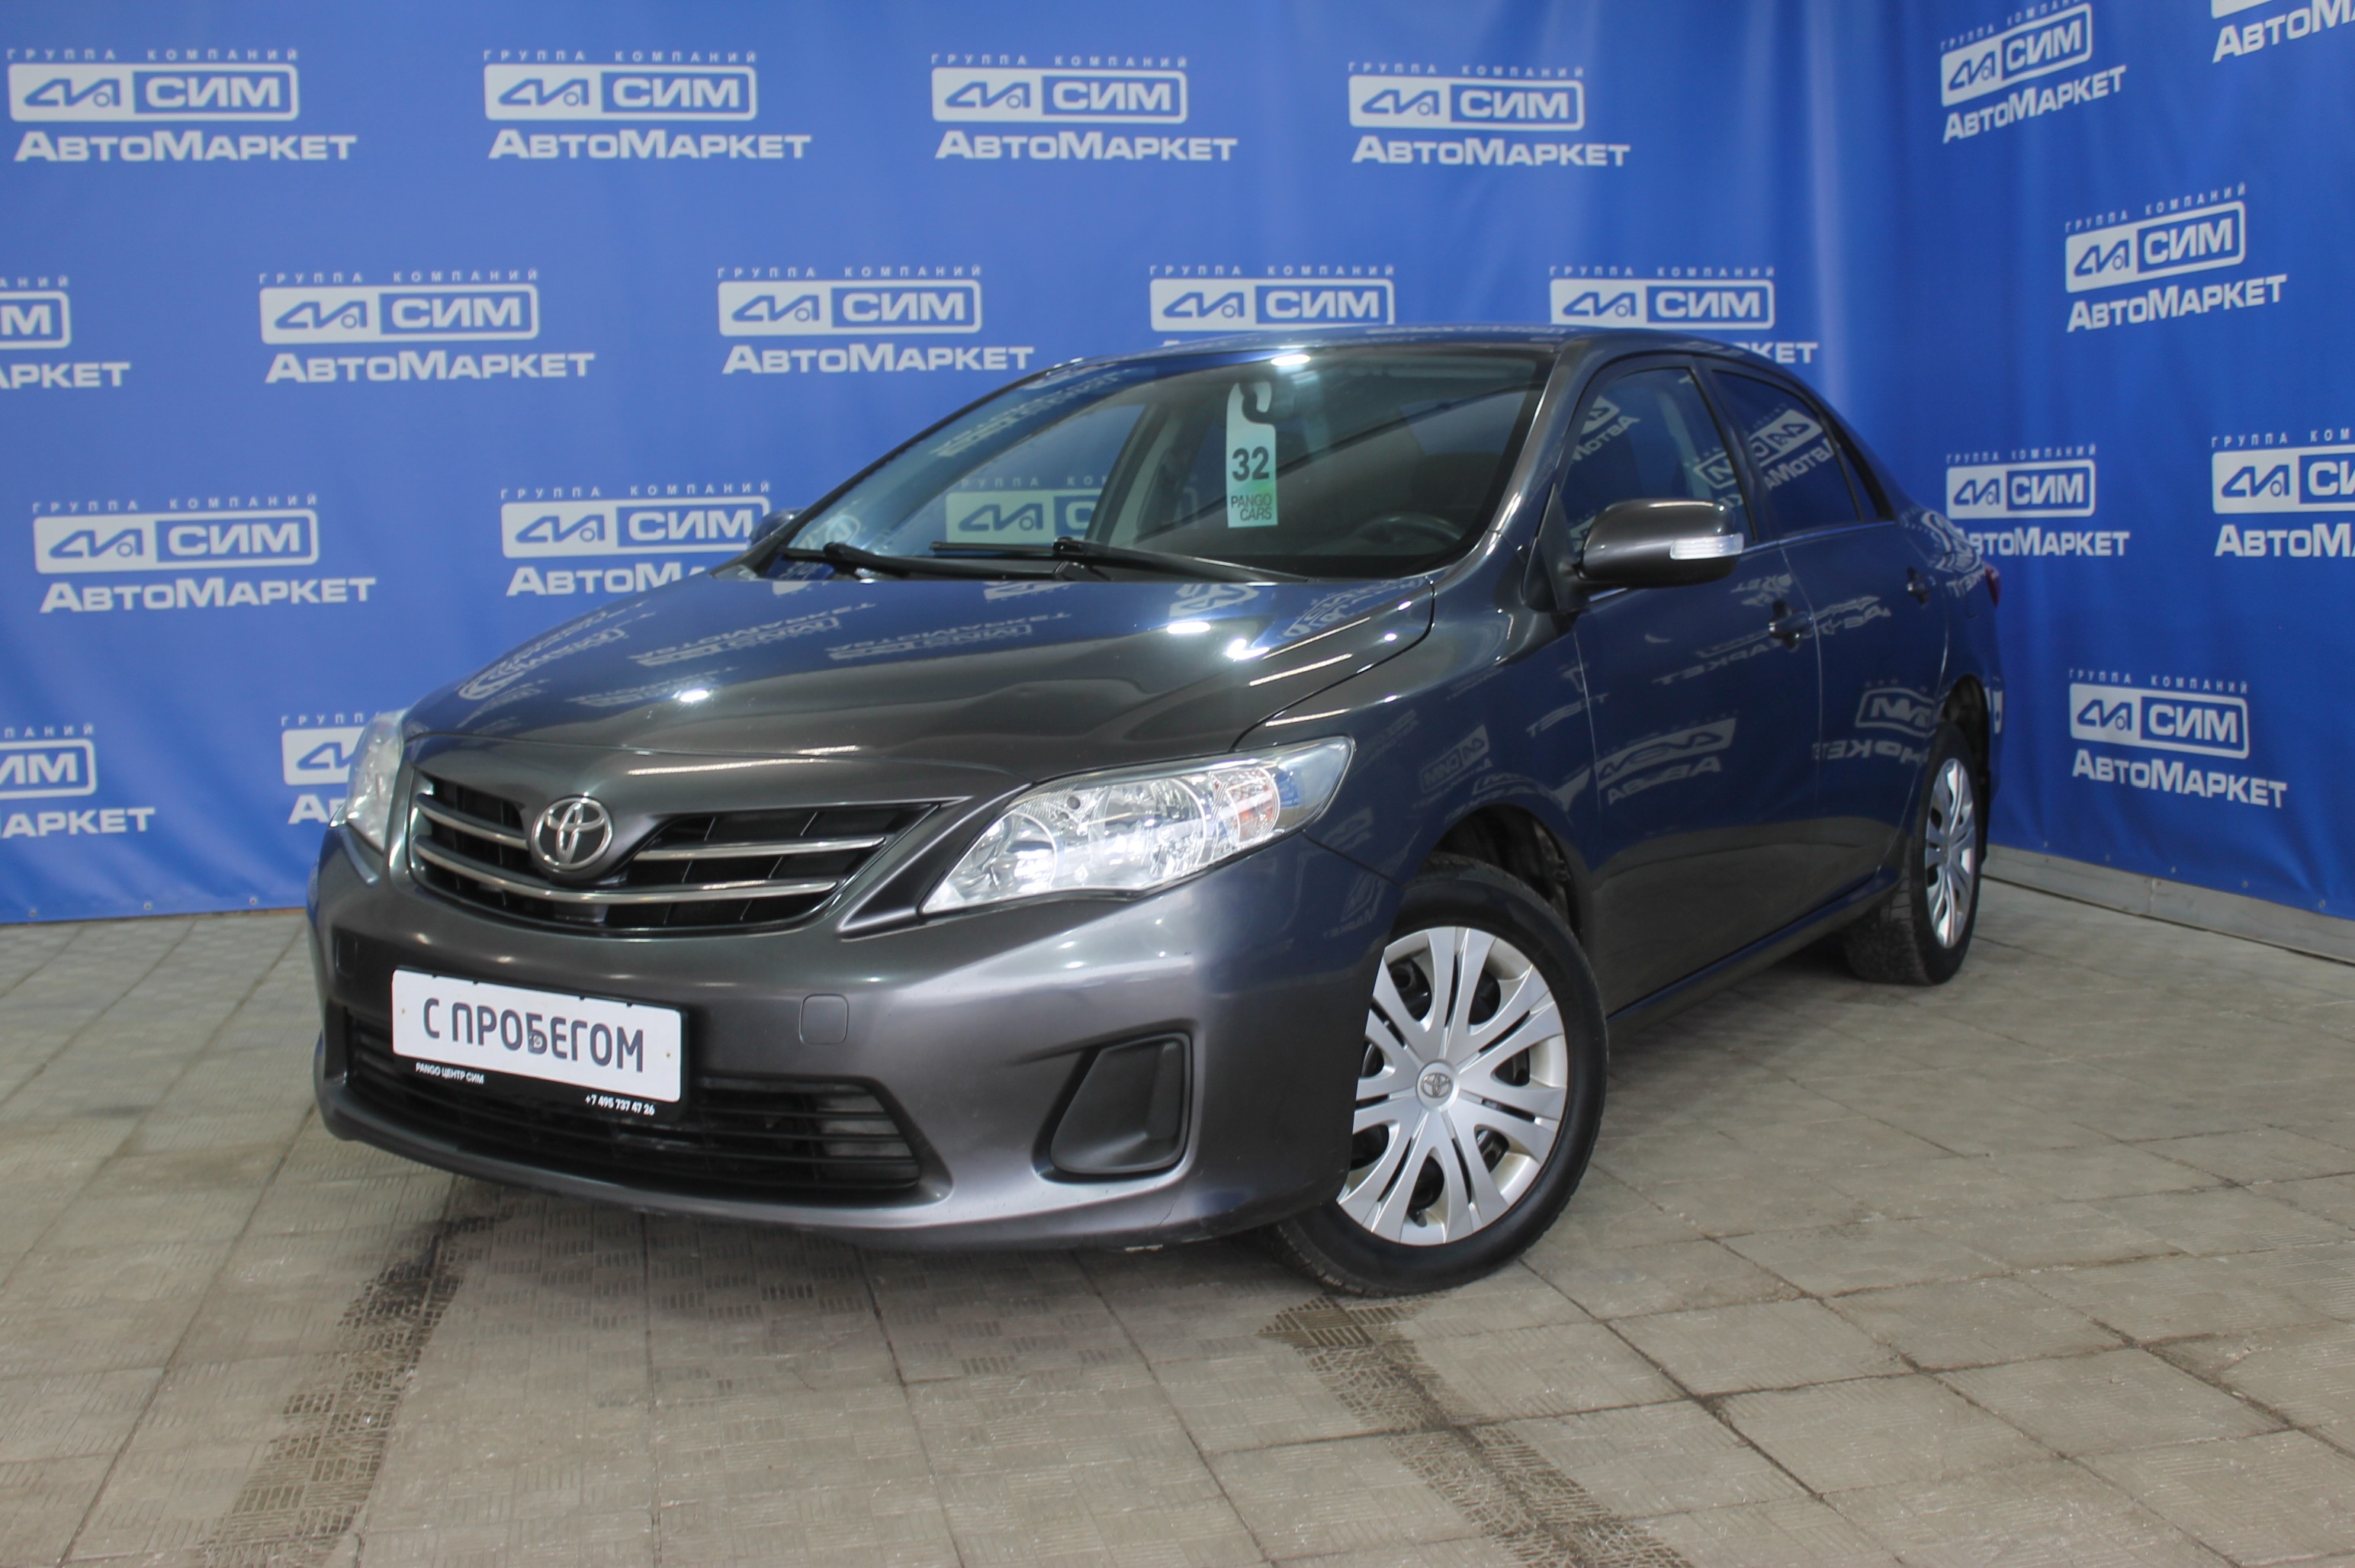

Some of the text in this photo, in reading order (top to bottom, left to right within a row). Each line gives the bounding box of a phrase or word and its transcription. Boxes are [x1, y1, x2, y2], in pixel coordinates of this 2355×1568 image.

[2006, 19, 2081, 71] СИМ
[2212, 0, 2355, 63] АВТОМ
[7, 48, 297, 60] ГРУППА КОМПАНИЙ
[484, 50, 756, 63] ГРУППА КОМПАНИЙ
[931, 53, 1187, 68] ГРУППА КОМПАНИЙ
[1348, 61, 1584, 78] ГРУППА КОМПАНИЙ
[146, 77, 279, 107] СИМ
[613, 78, 738, 107] СИМ
[1053, 82, 1171, 110] СИМ
[1460, 90, 1569, 118] СИМ
[2066, 182, 2246, 232] ГРУППА КОМПАНИЙ
[2145, 218, 2232, 264] СИМ
[259, 268, 537, 284] ГРУППА КОМПАНИЙ
[718, 265, 981, 278] ГРУППА КОМПАНИЙ
[1149, 265, 1394, 276] ГРУППА КОМПАНИЙ
[1549, 265, 1775, 277] ГРУППА КОМПАНИЙ
[392, 297, 520, 328] СИМ
[843, 293, 964, 321] СИМ
[1266, 291, 1379, 318] СИМ
[1656, 291, 1760, 317] СИМ
[2212, 432, 2288, 447] ГРУППА
[1232, 446, 1270, 481] 32
[500, 481, 769, 500] ГРУППА КОМПАНИЙ
[1230, 493, 1273, 509] PANGO
[2012, 474, 2084, 504] СИМ
[32, 493, 316, 513] ГРУППА КОМПАНИЙ
[1240, 507, 1273, 521] CARS
[628, 509, 752, 540] СИМ
[169, 523, 299, 555] СИМ
[1954, 526, 2131, 556] ВТОМАРКЕТ
[2215, 522, 2355, 557] АВТОМ
[506, 561, 706, 596] АВТОМ
[2070, 669, 2247, 693] ГРУППА КОМПАНИЙ
[281, 712, 380, 726] ГРУПП
[2149, 705, 2237, 743] СИМ
[423, 998, 644, 1072] С ПРОБЕГОМ
[416, 1062, 441, 1076] PANGO
[585, 1094, 597, 1106] +7
